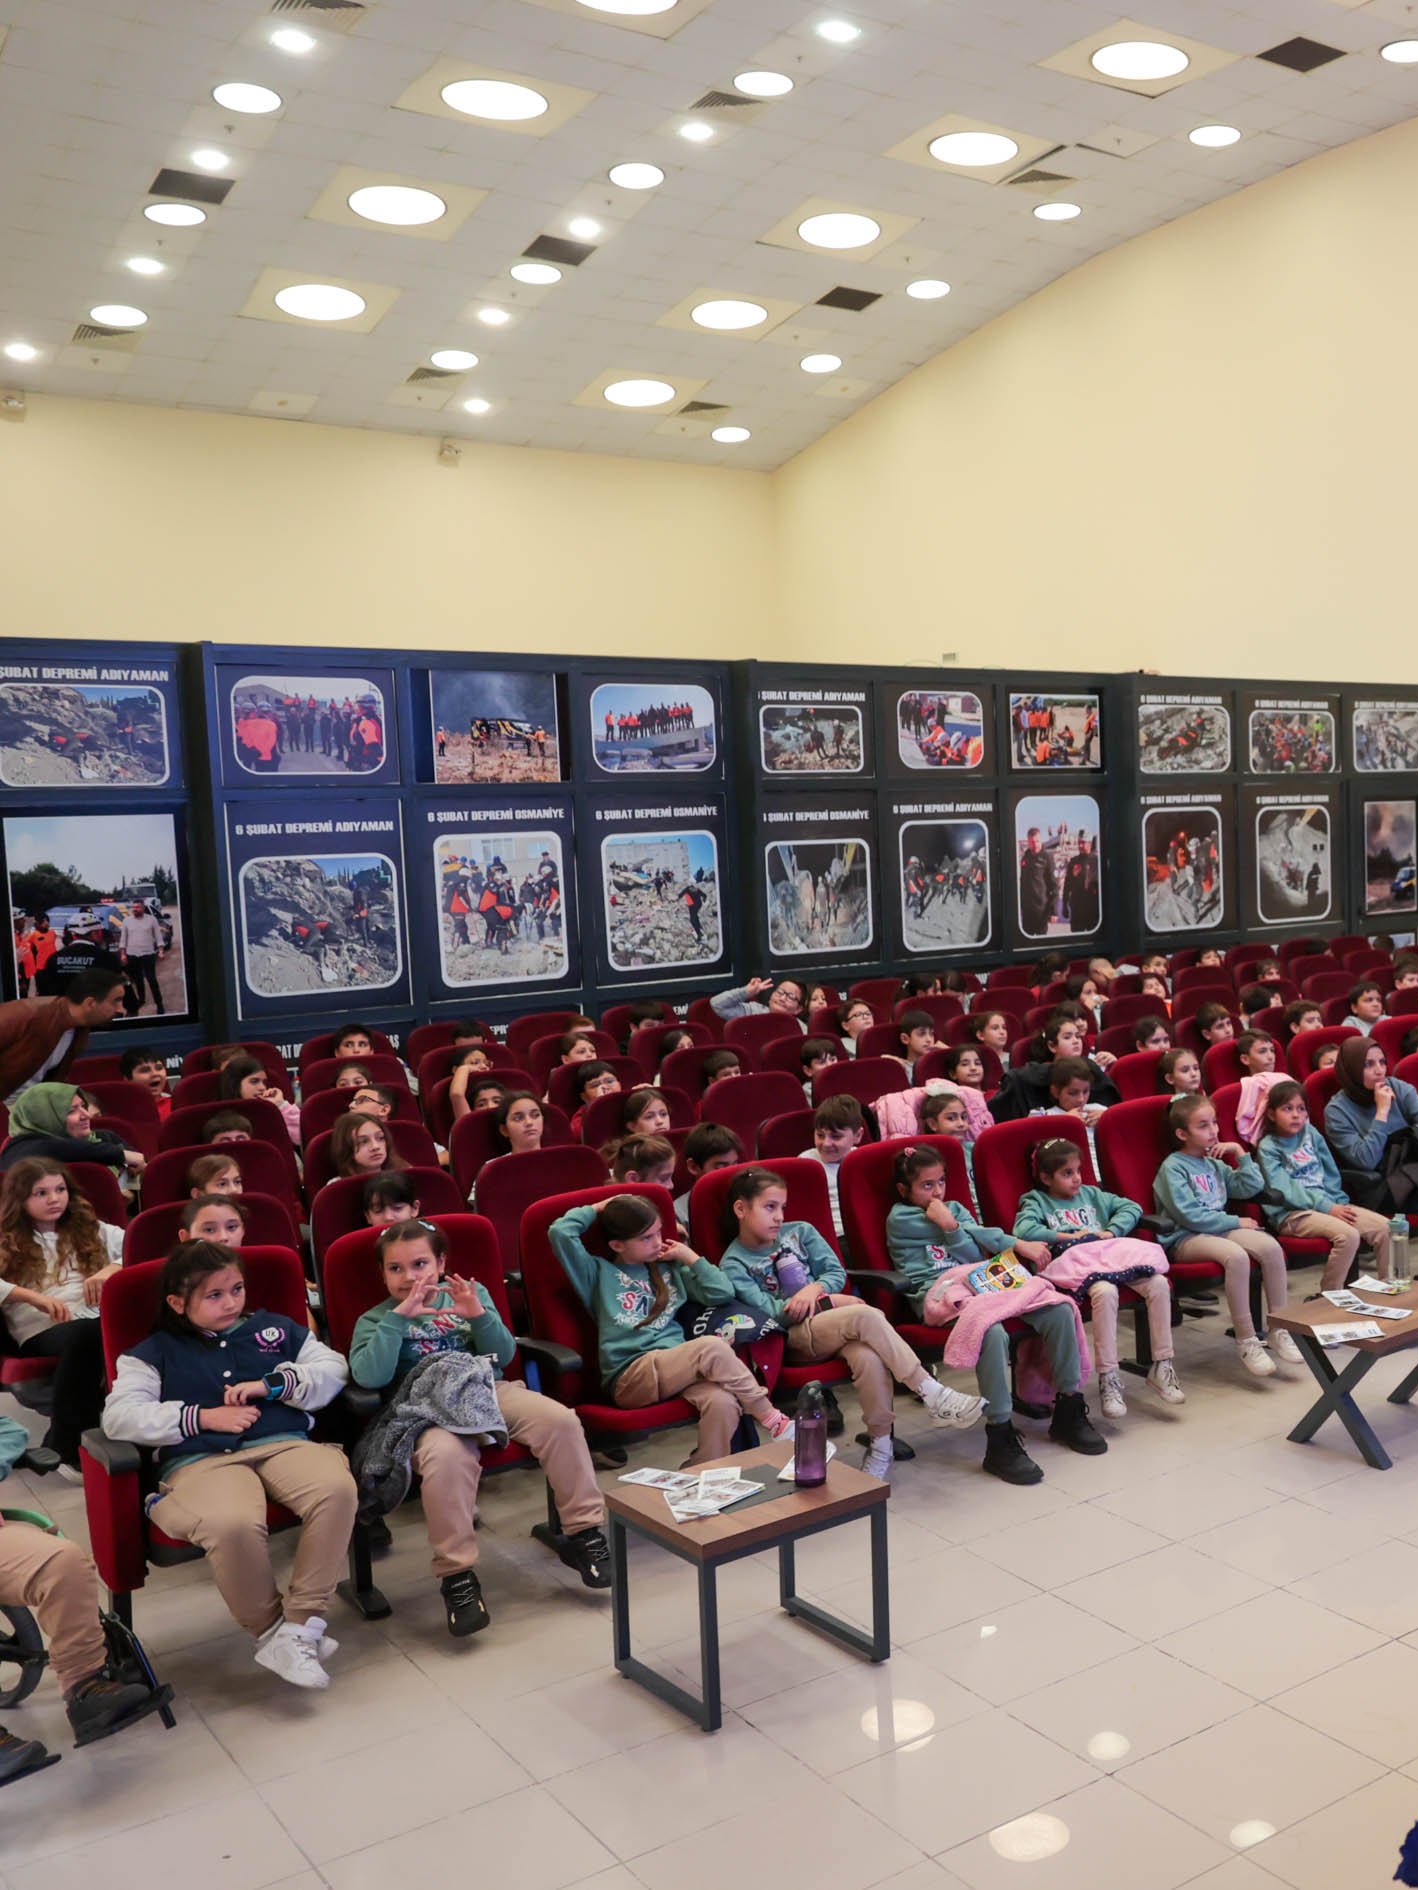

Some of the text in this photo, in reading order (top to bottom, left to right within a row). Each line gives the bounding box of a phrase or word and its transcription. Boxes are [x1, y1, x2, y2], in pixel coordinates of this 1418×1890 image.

[0, 666, 169, 682] ŞUBAT DEPREMİ ADIYAMAN
[437, 811, 469, 823] ŞUBAT
[471, 808, 513, 820] DEPREMİ
[515, 807, 565, 819] OSMANİYE
[604, 809, 633, 821] ŞUBAT
[634, 806, 672, 819] DEPREMİ
[673, 804, 718, 817] OSMANİYE
[235, 820, 394, 836] 6 ŞUBAT DEPREMİ ADIYAMAN
